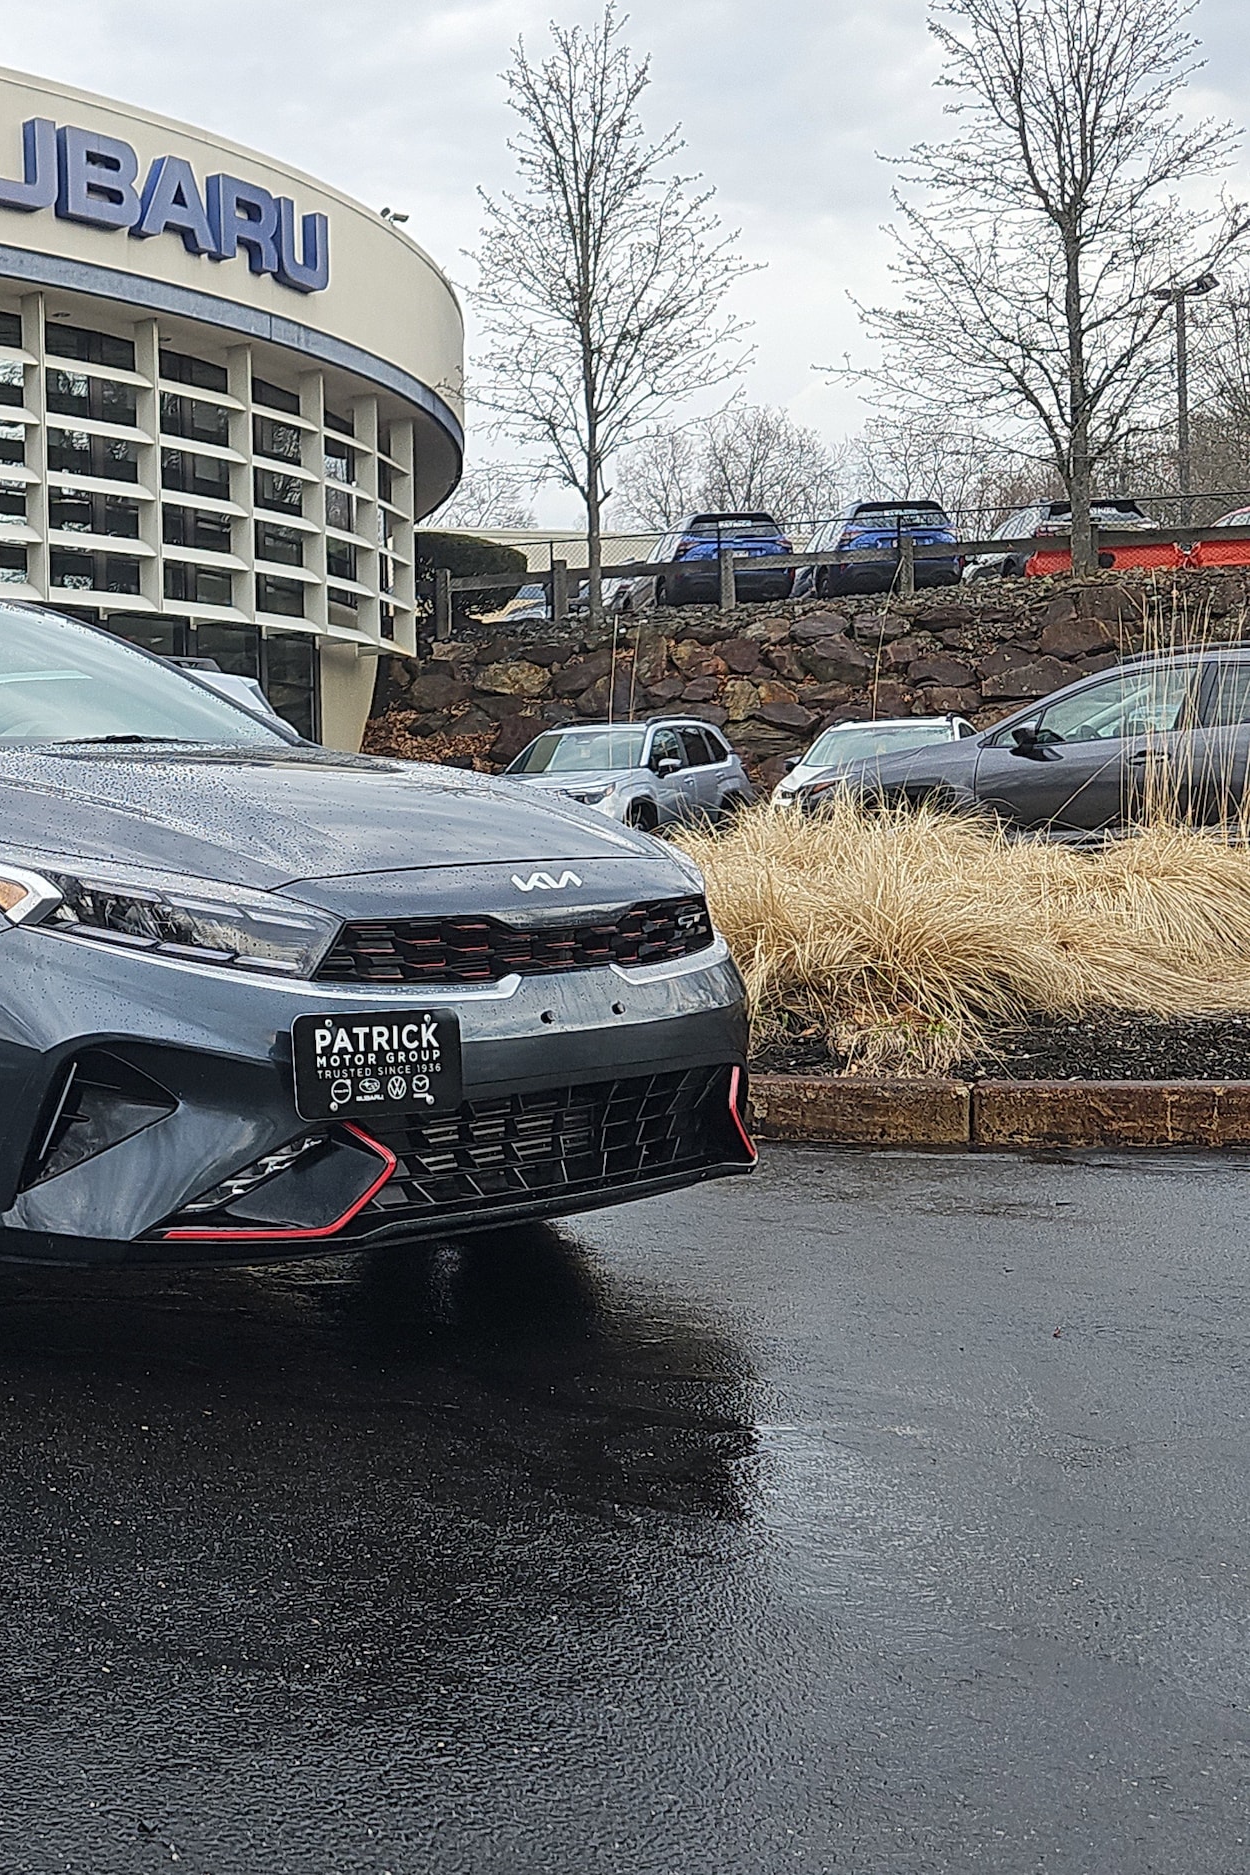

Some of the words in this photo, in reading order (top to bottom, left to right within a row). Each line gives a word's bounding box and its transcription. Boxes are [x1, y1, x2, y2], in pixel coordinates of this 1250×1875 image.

[315, 1022, 440, 1054] PATRICK
[316, 1053, 377, 1068] MOTOR
[386, 1049, 440, 1064] GROUP
[317, 1067, 372, 1079] TRUSTED
[377, 1064, 411, 1076] SINCE
[416, 1062, 441, 1073] 1936
